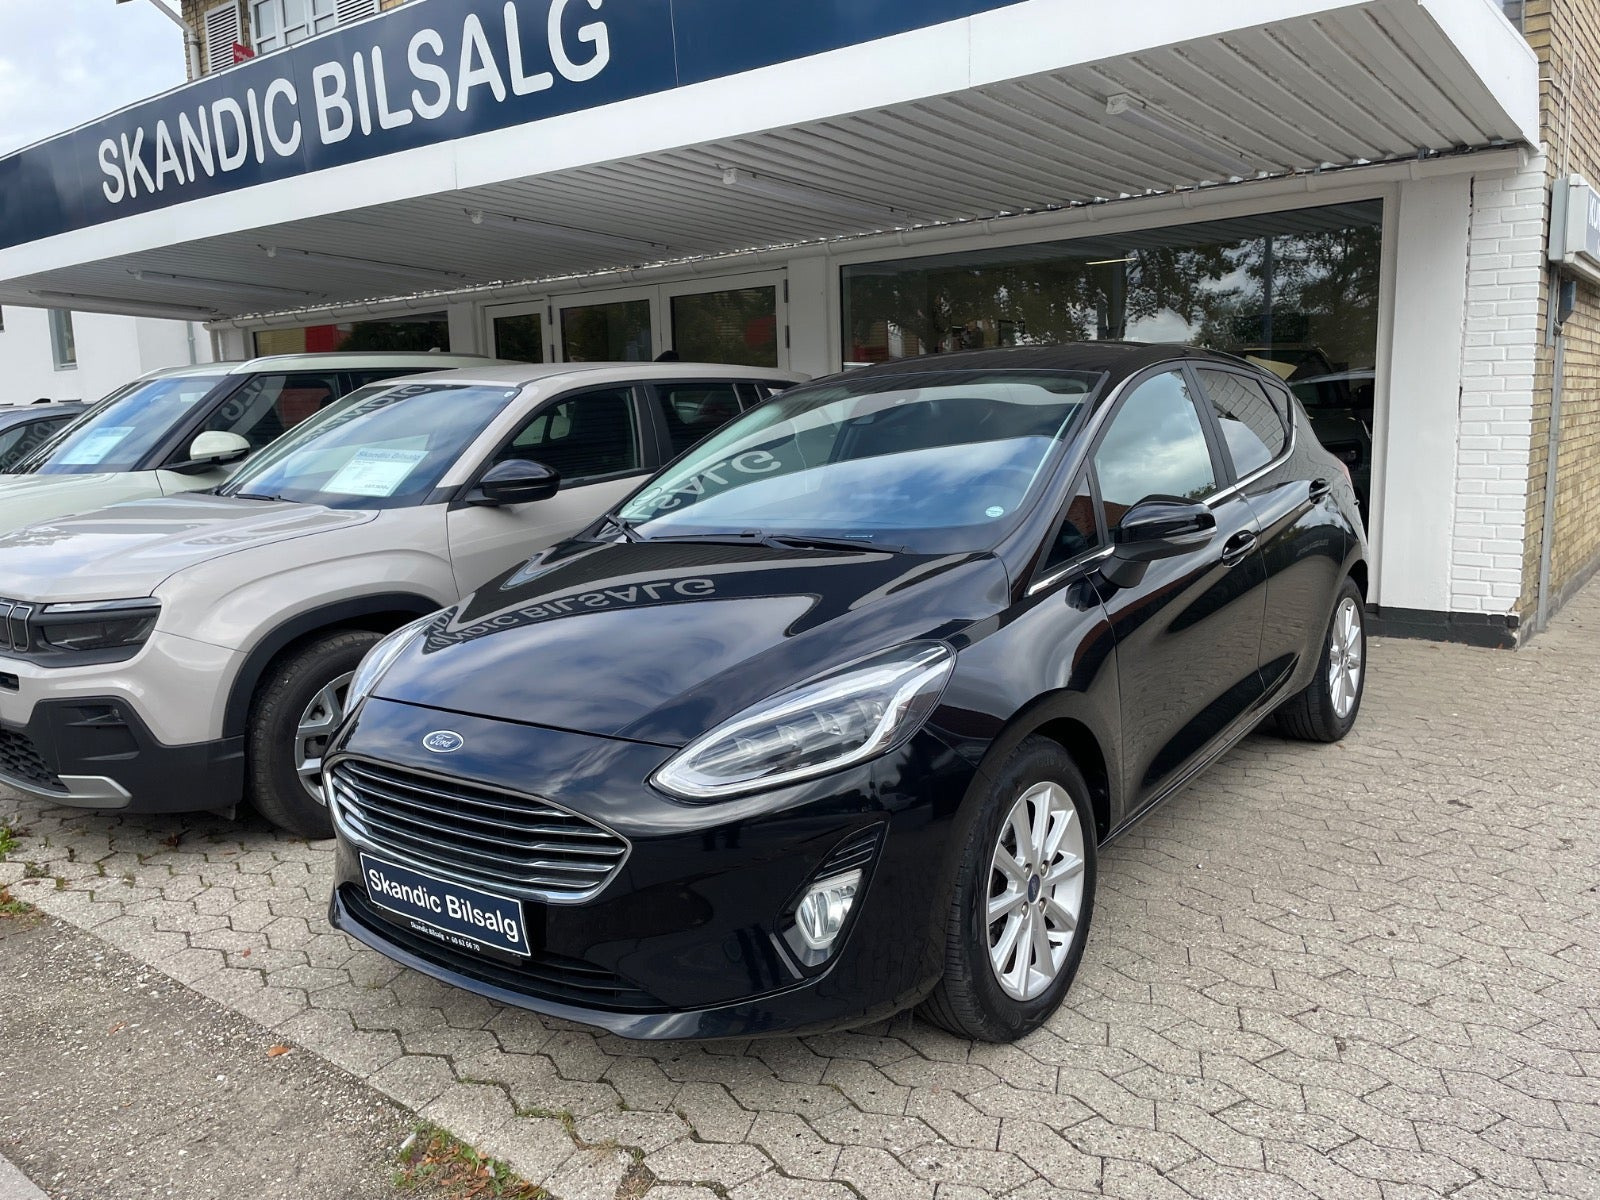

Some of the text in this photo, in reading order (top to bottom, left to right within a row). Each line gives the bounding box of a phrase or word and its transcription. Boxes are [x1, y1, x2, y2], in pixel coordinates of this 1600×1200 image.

[97, 0, 610, 204] SKANDIC BILSALG
[428, 732, 458, 749] Ford
[368, 868, 520, 943] Skandic Bilsalg
[410, 921, 429, 934] Skandic
